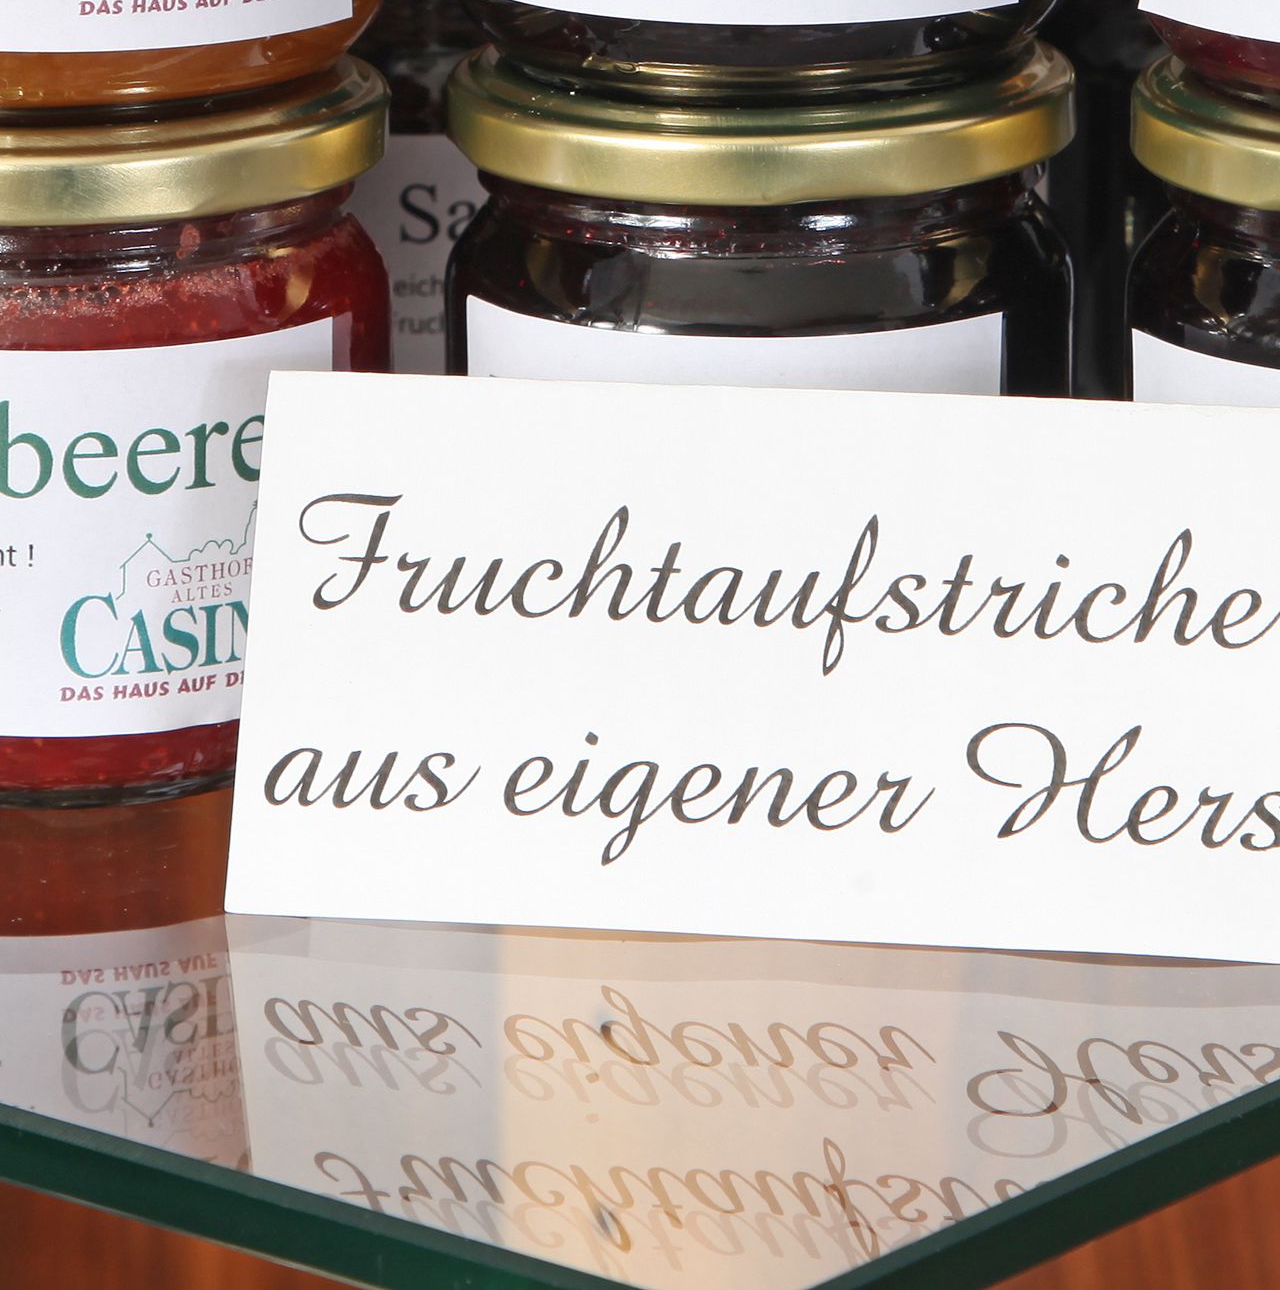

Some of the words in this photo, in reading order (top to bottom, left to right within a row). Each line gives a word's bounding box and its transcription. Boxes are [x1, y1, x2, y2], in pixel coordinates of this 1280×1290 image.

[147, 557, 253, 587] GASTHOF
[171, 582, 233, 603] ALTES
[60, 592, 249, 679] CASIN
[60, 686, 104, 702] DAS
[113, 681, 170, 700] HAUS
[177, 674, 217, 694] AUF
[263, 744, 481, 813] aus
[503, 731, 936, 866] eigener
